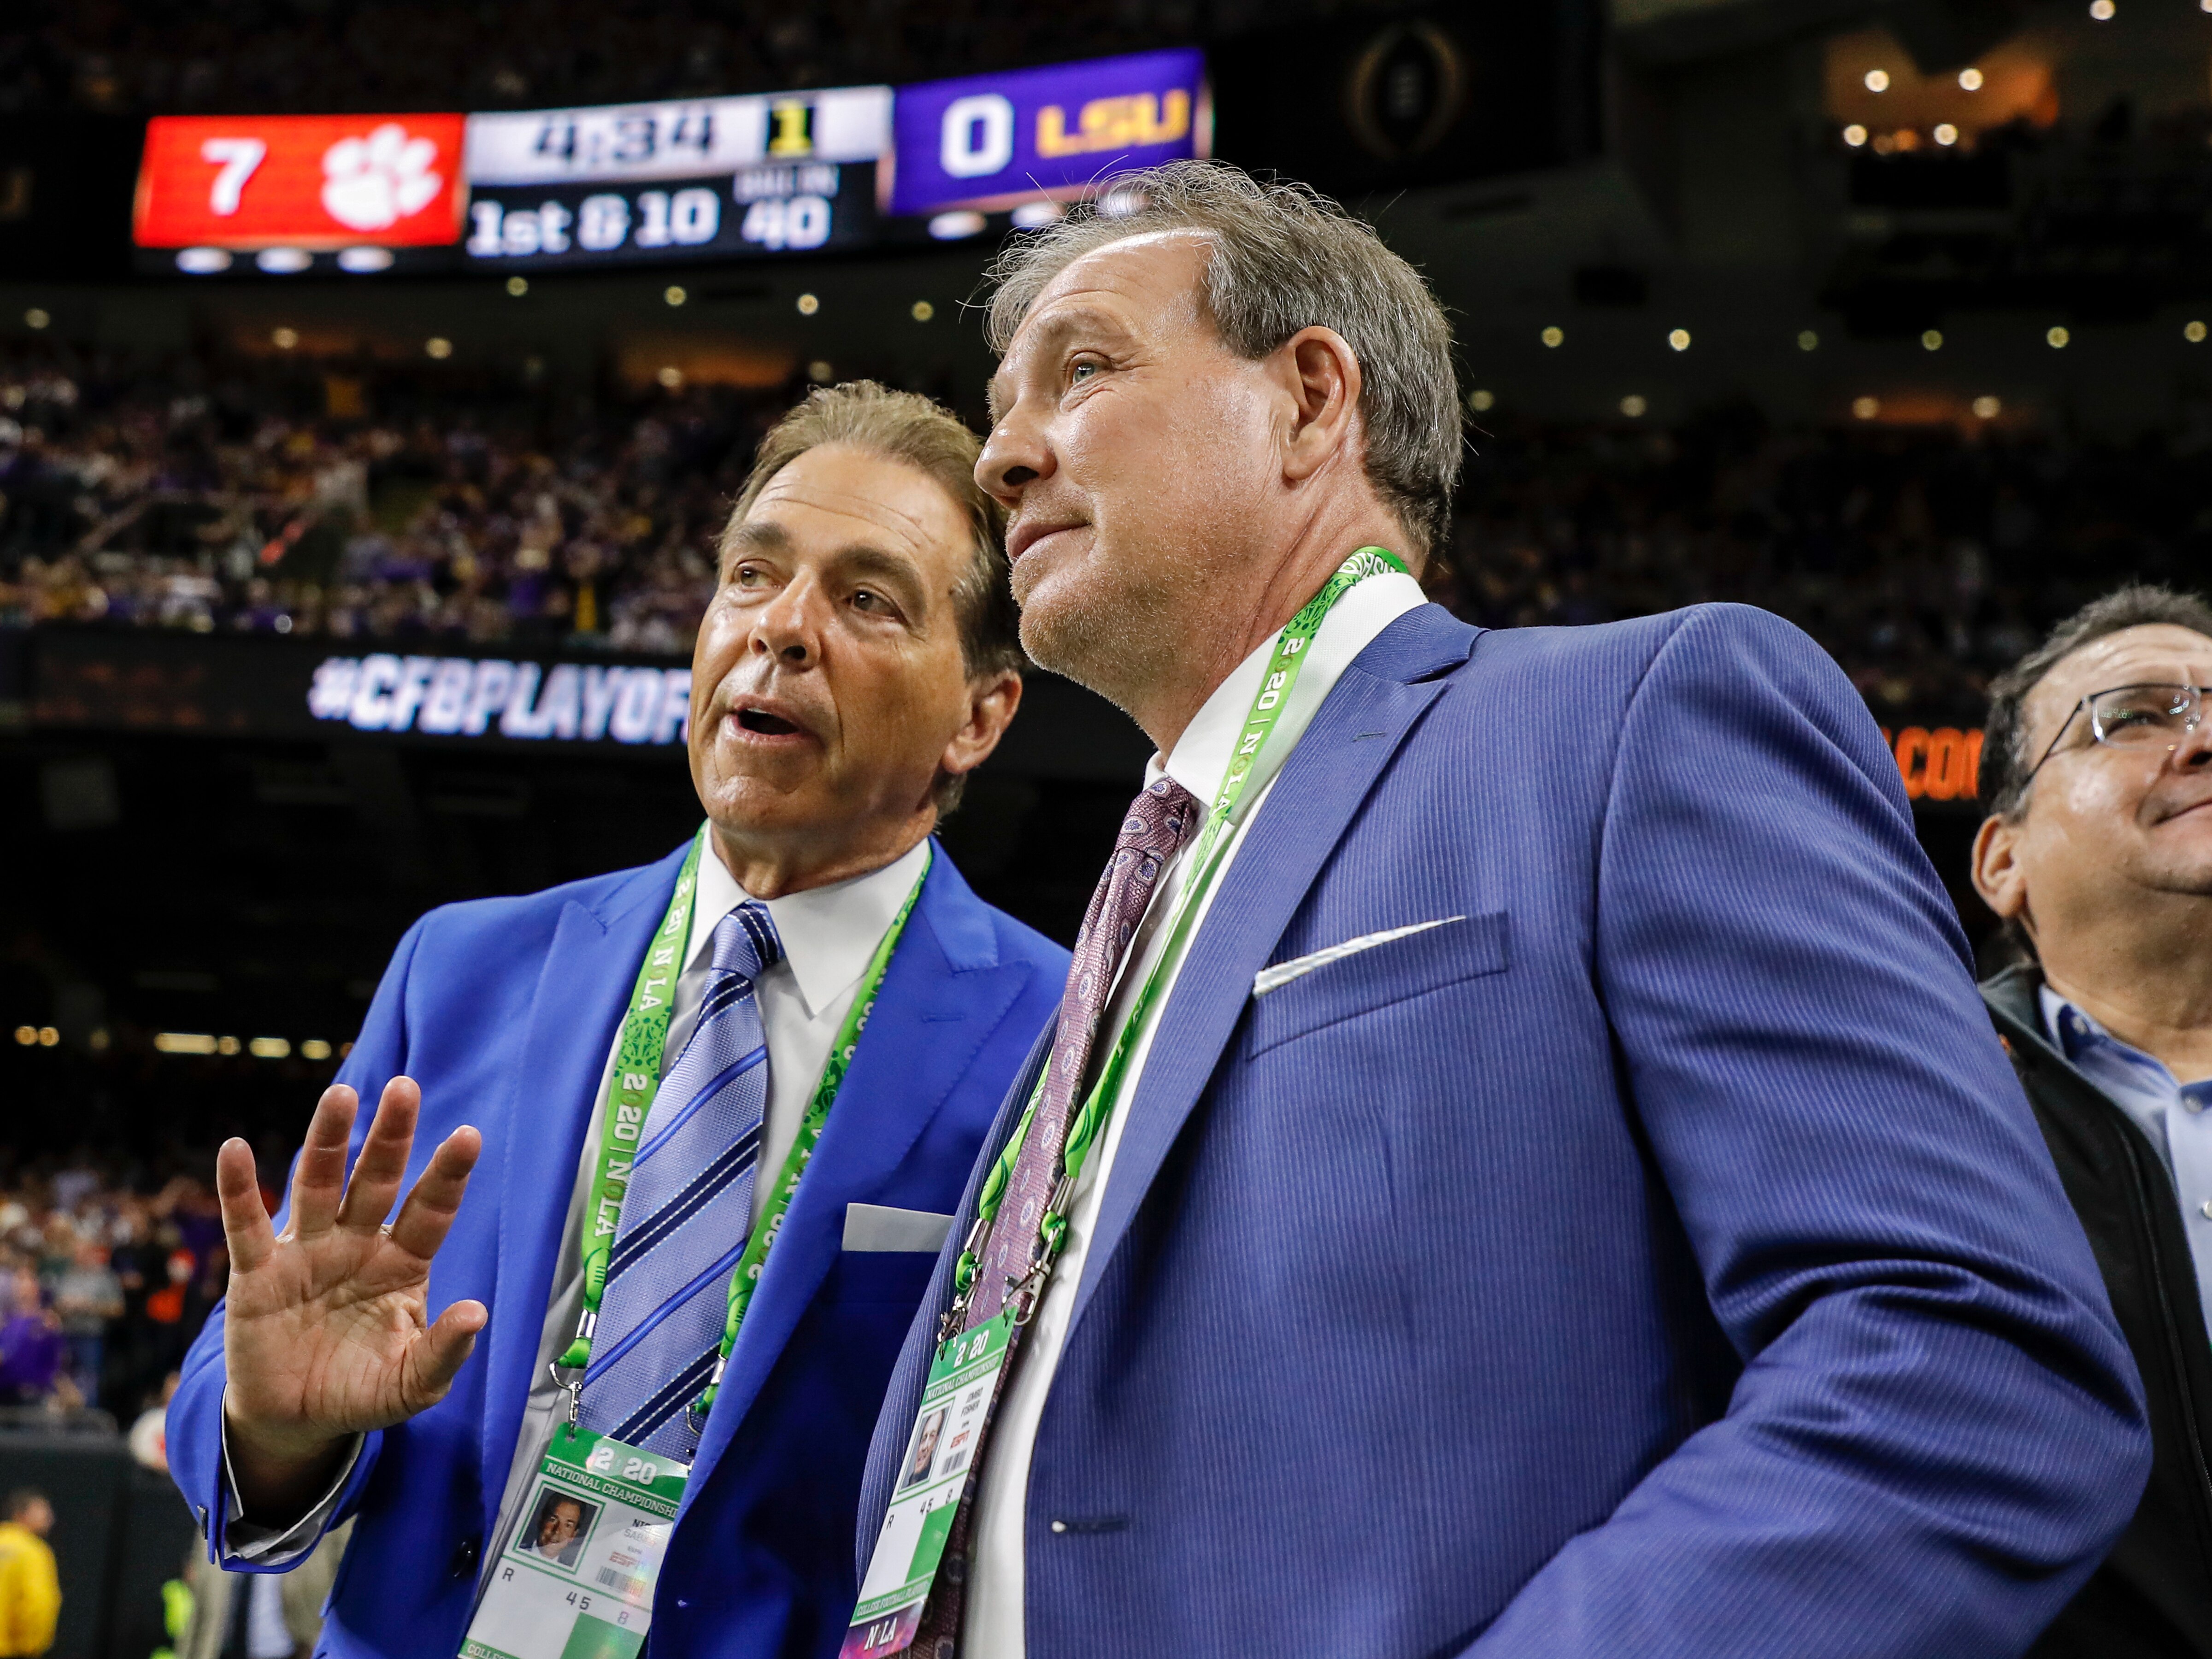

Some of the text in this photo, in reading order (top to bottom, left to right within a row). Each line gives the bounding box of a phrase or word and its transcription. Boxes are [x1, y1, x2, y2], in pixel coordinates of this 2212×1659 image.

[532, 114, 713, 162] 4:34
[768, 100, 812, 157] 1
[940, 94, 1014, 178] 0
[1036, 90, 1190, 159] LSU
[200, 137, 266, 215] 7
[466, 200, 572, 258] 1st
[635, 188, 720, 248] 10
[741, 195, 831, 251] 40
[307, 653, 689, 745] #CFBPLAYOF
[1212, 730, 1263, 817] NOLA
[614, 1073, 648, 1141] 2020
[953, 1330, 989, 1368] 220
[546, 1462, 677, 1518] NATIONAL CHAMPIONSHI
[594, 1447, 657, 1485] 220
[886, 1514, 894, 1530] R
[502, 1568, 514, 1582] R
[618, 1611, 629, 1625] 8
[864, 1617, 898, 1651] NLA
